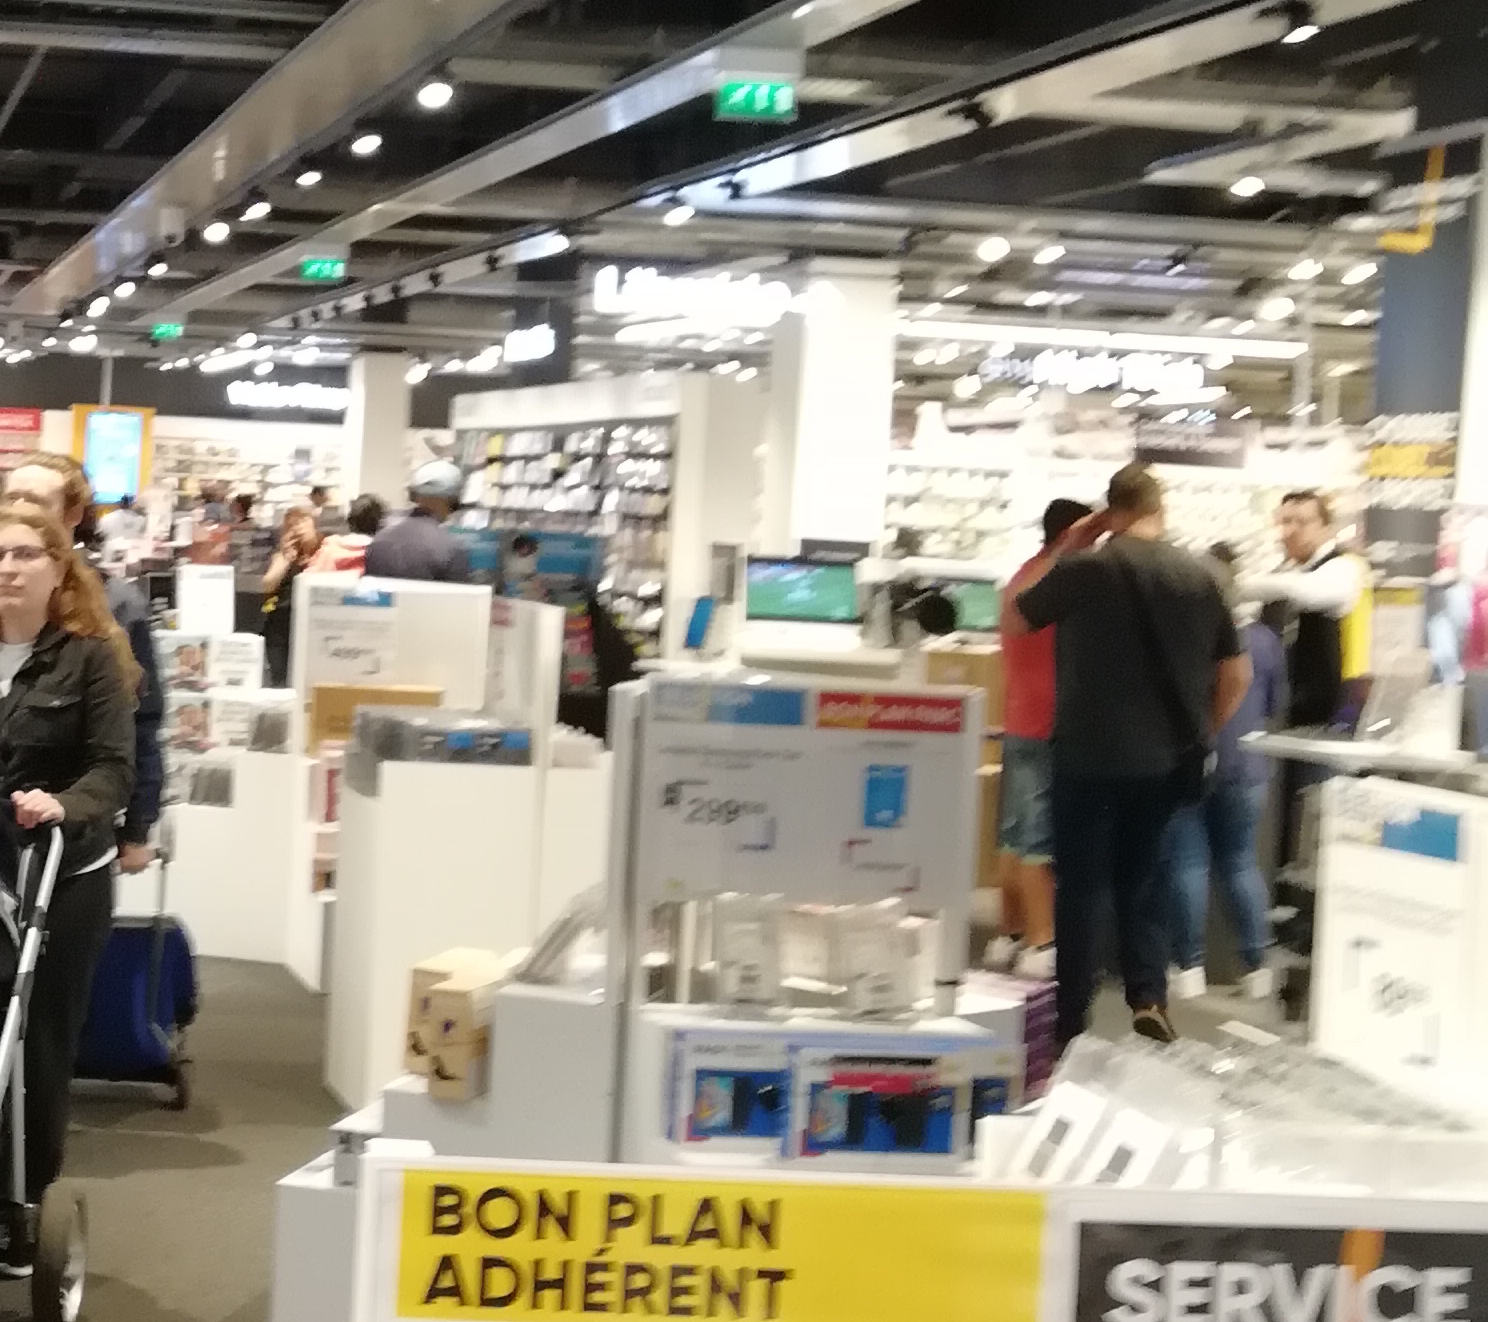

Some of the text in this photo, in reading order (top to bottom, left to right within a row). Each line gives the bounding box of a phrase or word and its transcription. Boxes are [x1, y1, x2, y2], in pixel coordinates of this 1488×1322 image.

[429, 1183, 784, 1250] BON PLAN
[420, 1243, 795, 1320] ADHÉRENT
